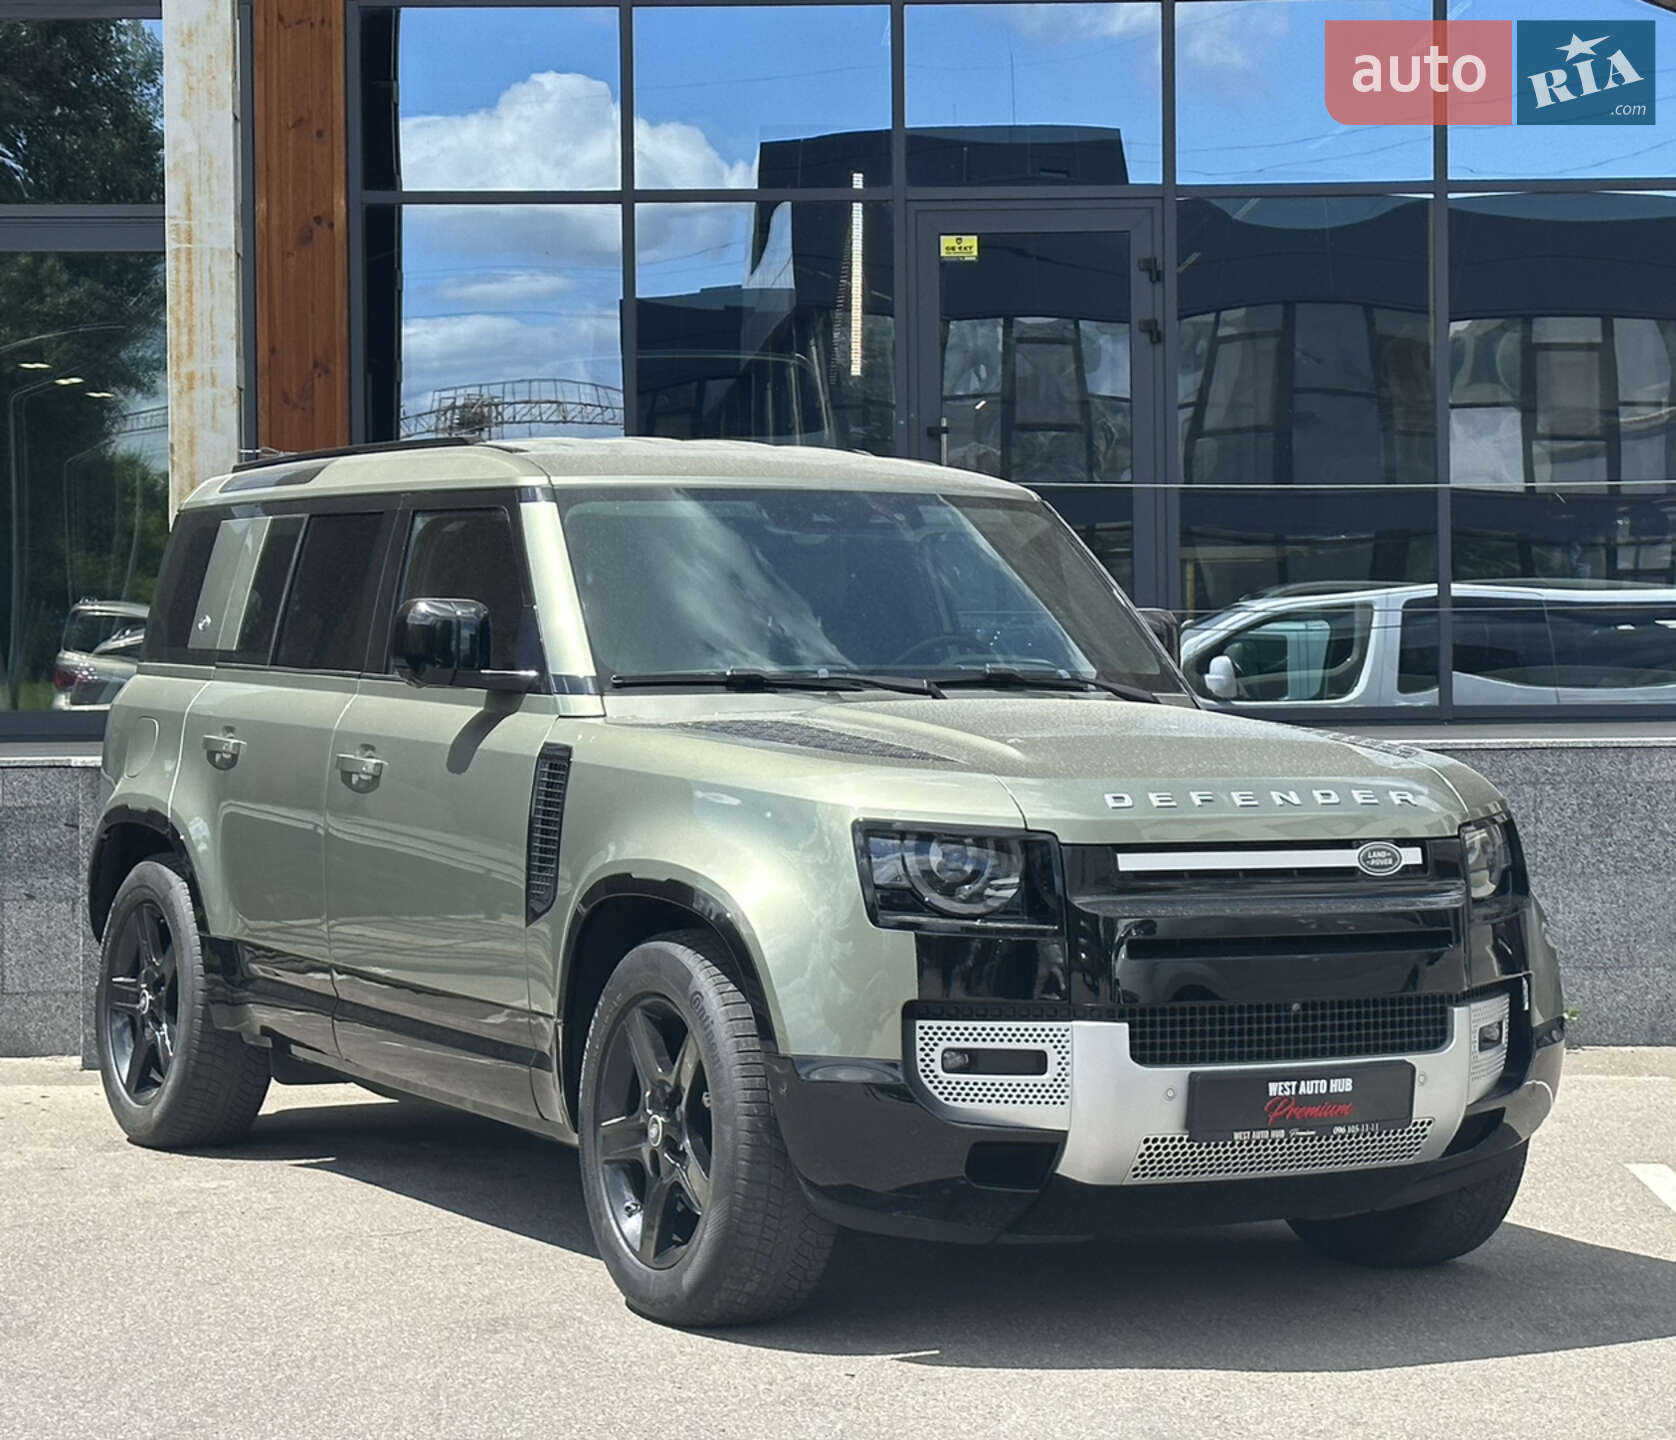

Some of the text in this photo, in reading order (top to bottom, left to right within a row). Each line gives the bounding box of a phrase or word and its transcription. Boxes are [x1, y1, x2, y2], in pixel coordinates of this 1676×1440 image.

[1104, 788, 1418, 809] DEFENDER
[1268, 1077, 1353, 1097] WEST AUTO HUB
[1263, 1096, 1354, 1127] Premium
